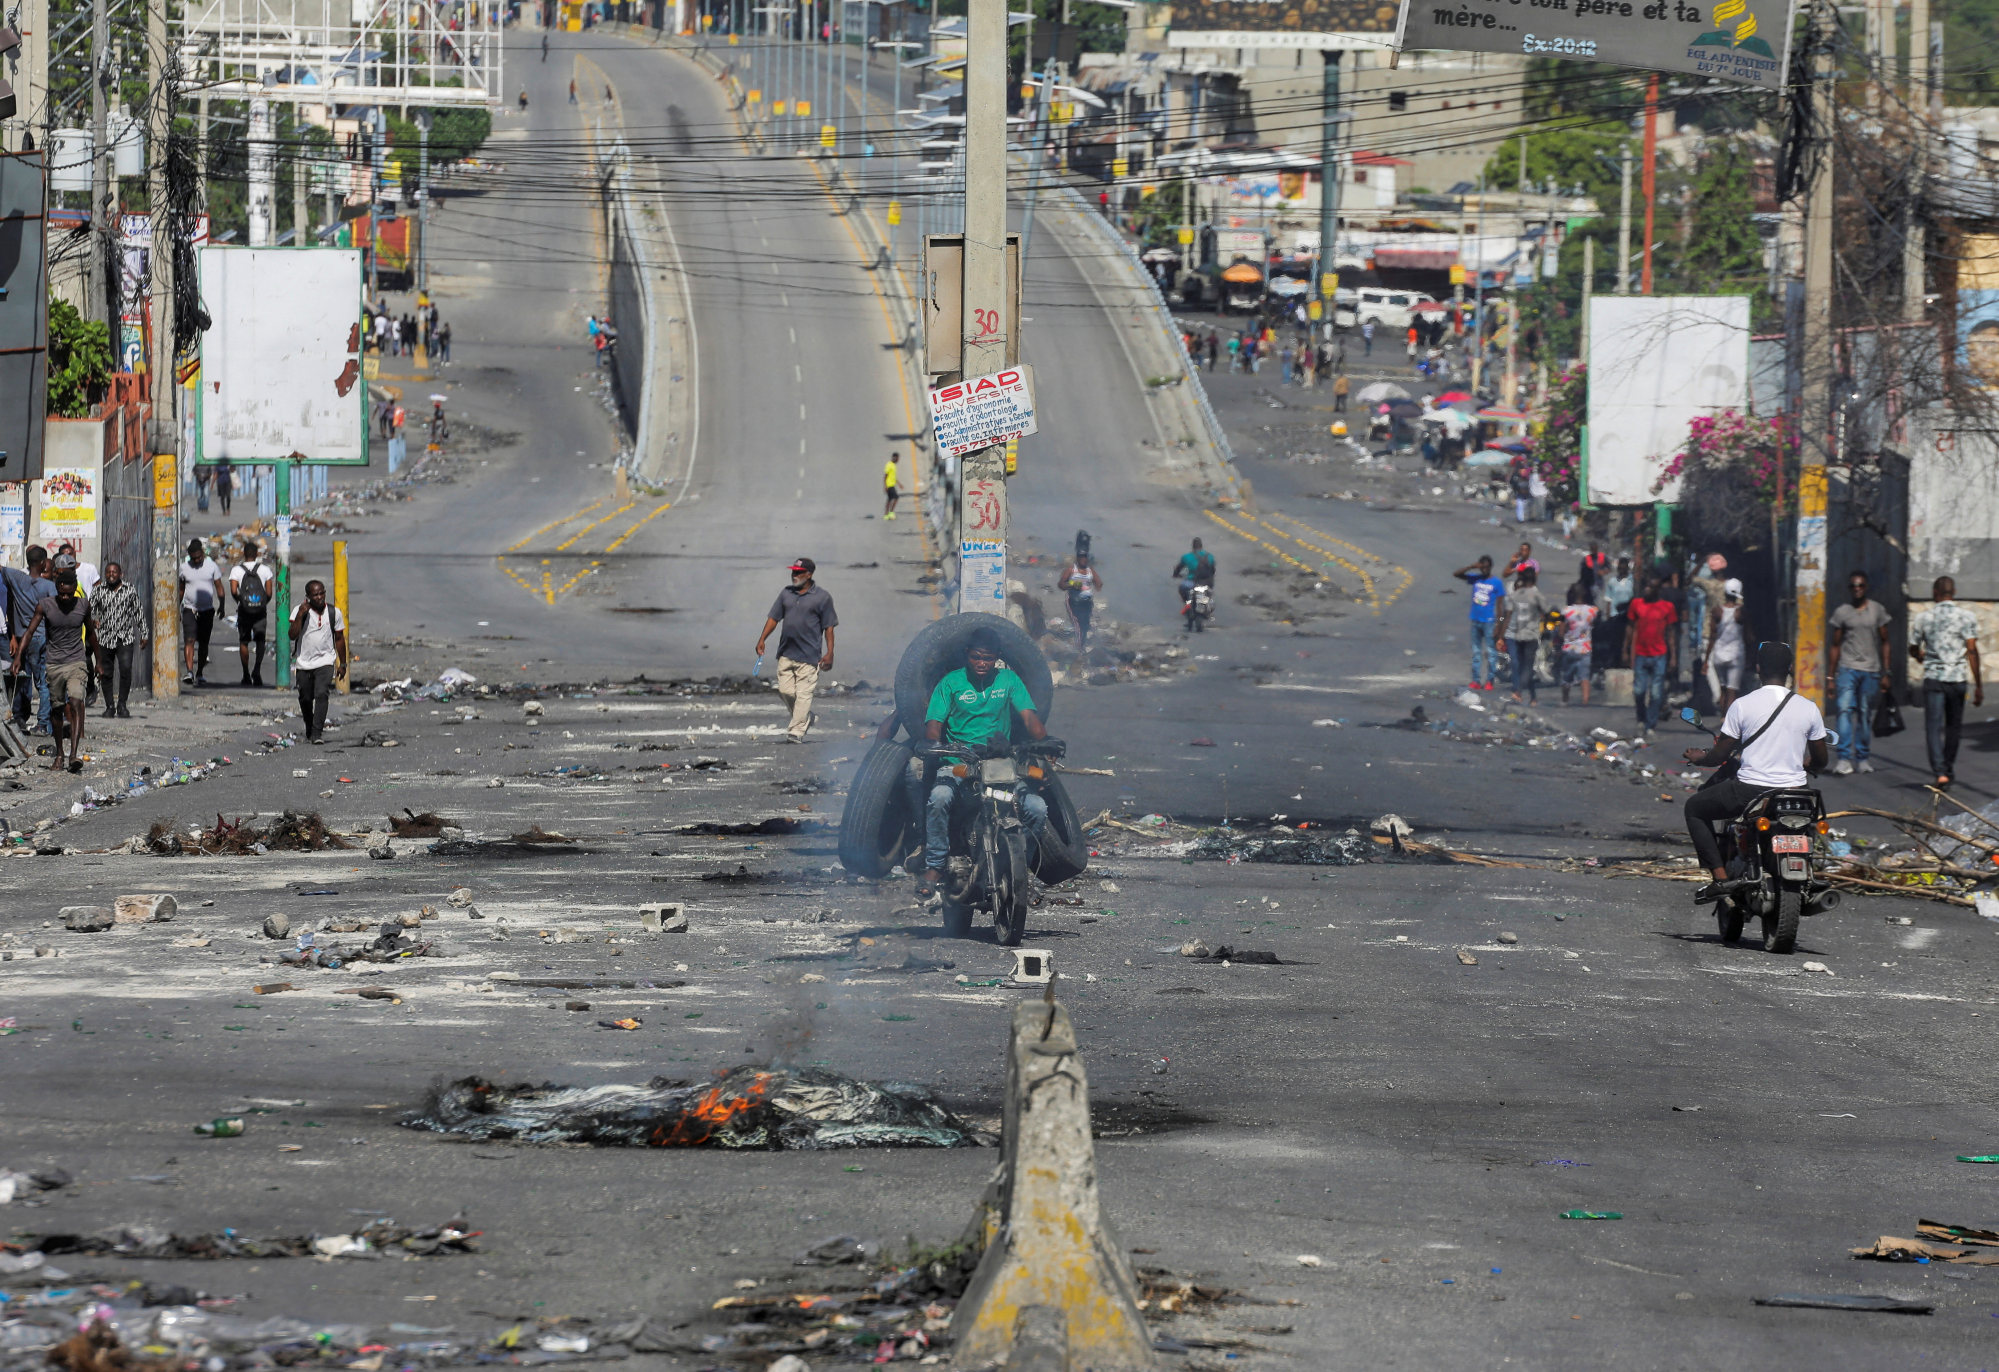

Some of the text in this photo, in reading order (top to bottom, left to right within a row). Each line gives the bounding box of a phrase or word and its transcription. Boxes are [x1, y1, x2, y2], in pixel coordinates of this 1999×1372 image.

[1643, 0, 1668, 20] et
[1674, 0, 1701, 23] ta
[1697, 61, 1714, 72] DU
[1731, 67, 1762, 81] JOUR
[1710, 53, 1777, 72] ADVENTISTE
[973, 308, 999, 337] 30
[935, 383, 1024, 414] UNIVERSITE
[968, 491, 1001, 531] 30
